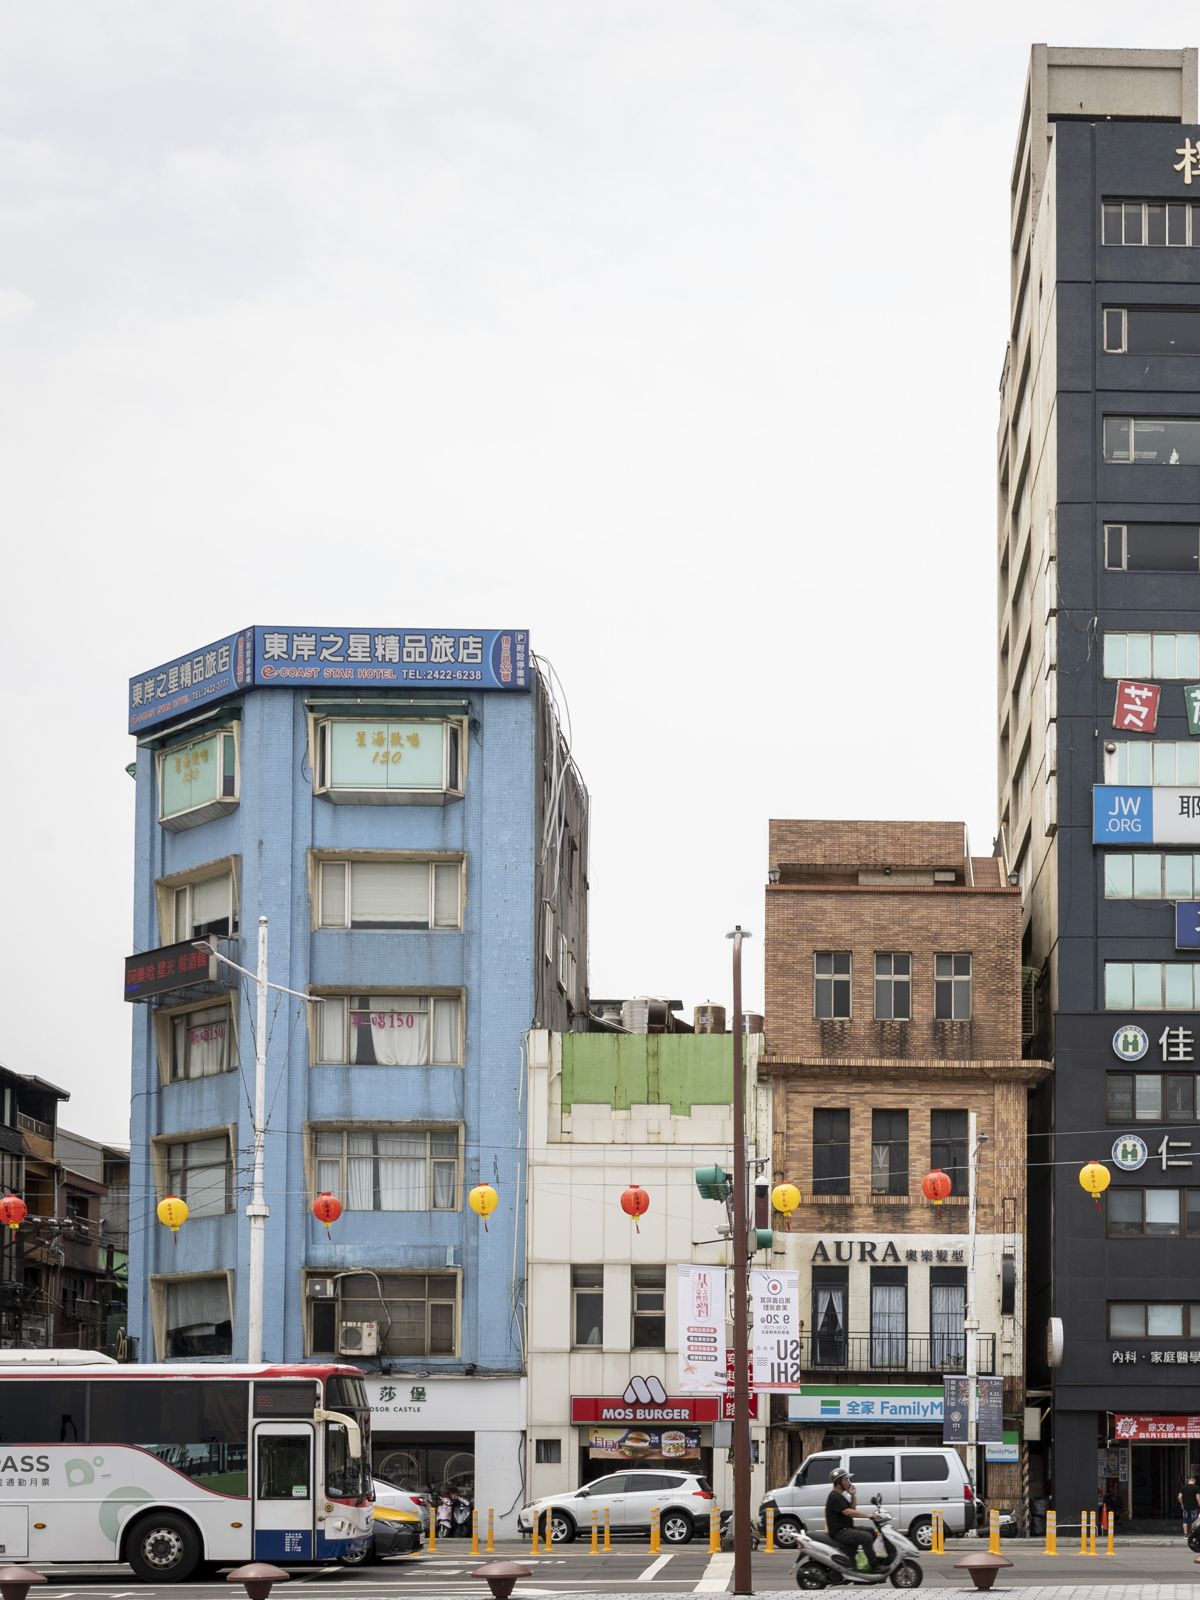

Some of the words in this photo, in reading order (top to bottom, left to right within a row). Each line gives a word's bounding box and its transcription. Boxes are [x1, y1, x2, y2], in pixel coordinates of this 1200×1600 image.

[263, 632, 482, 664] 東岸之星精品旅店
[132, 645, 230, 708] 東岸之星精品旅店
[323, 666, 355, 679] STAR
[358, 667, 397, 680] HOTEL
[402, 669, 482, 680] TEL:2422-6238
[1109, 796, 1141, 816] JW
[811, 1240, 901, 1263] AURA
[1112, 1351, 1137, 1364] 內科
[379, 1386, 427, 1402] 莎堡
[602, 1408, 634, 1420] MOS
[636, 1408, 689, 1420] BURGER
[846, 1400, 875, 1415] 全家
[880, 1402, 943, 1417] FamilyM
[0, 1455, 50, 1472] ASS
